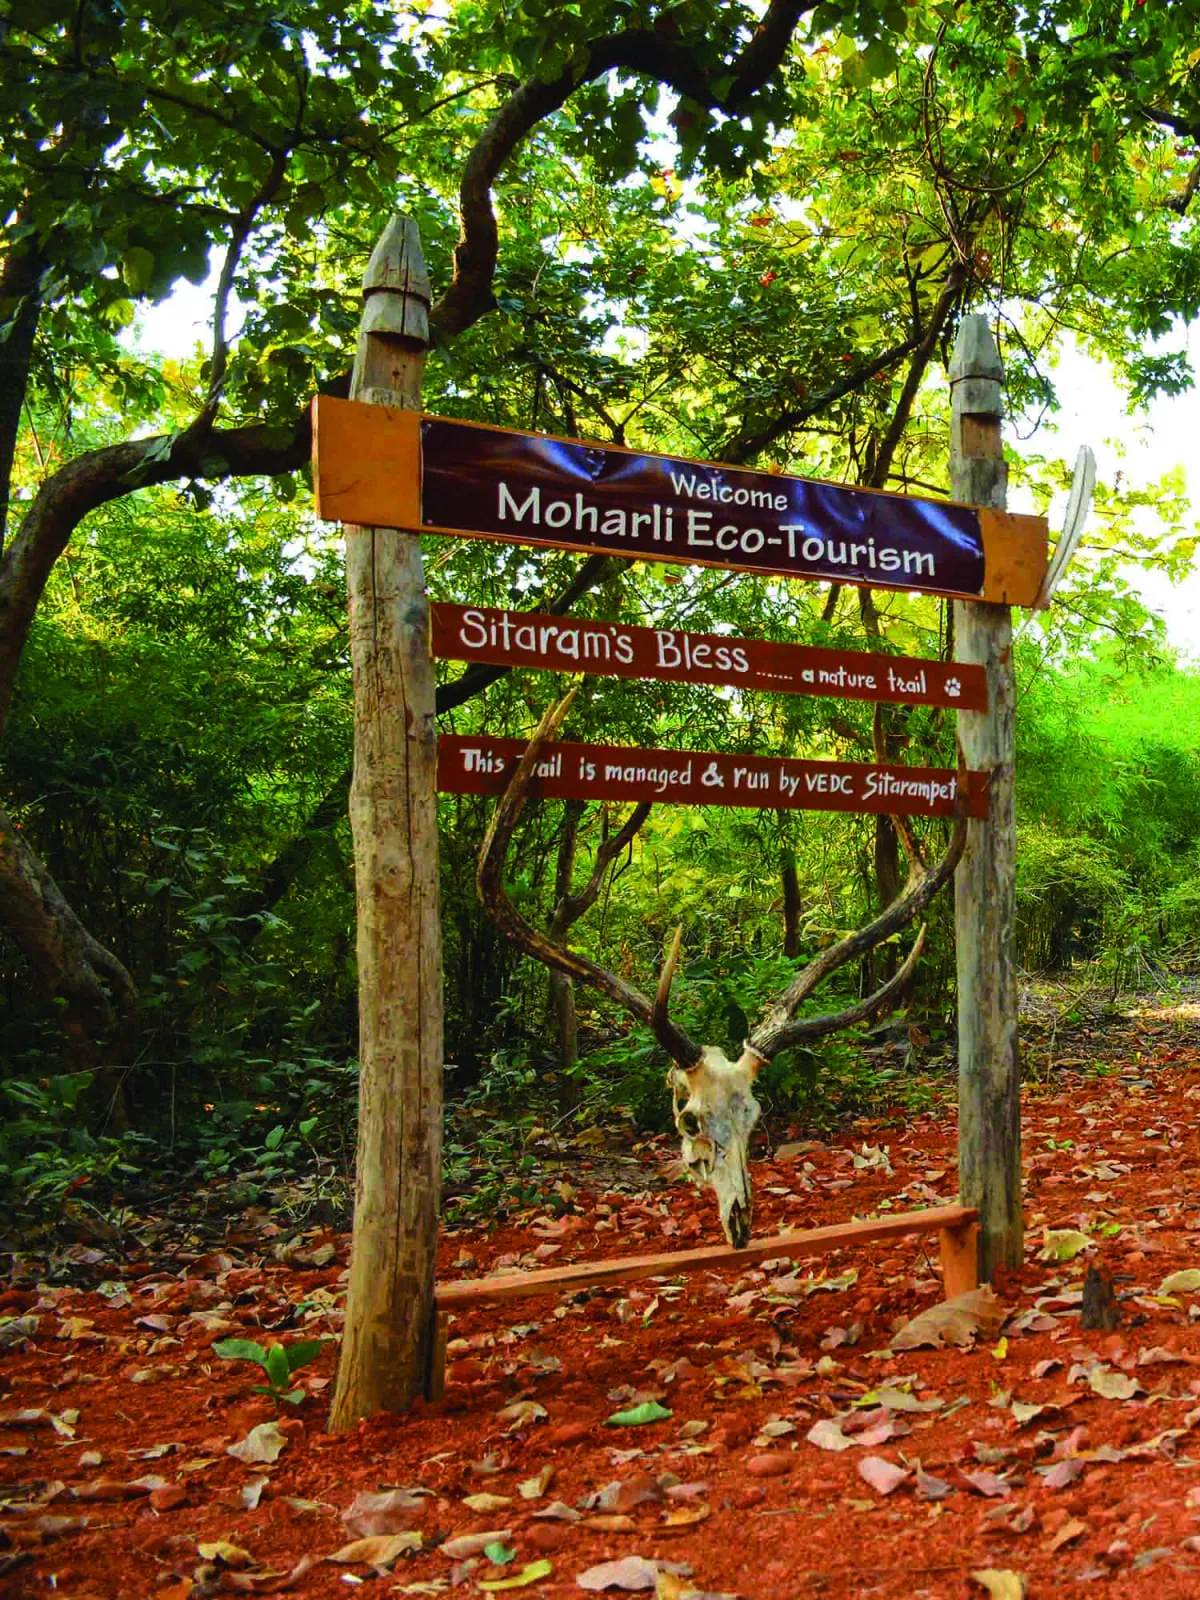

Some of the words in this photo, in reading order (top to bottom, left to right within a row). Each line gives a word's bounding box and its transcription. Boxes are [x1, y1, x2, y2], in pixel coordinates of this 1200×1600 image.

[670, 471, 788, 511] Welcome
[498, 481, 673, 543] Moharli
[687, 510, 935, 577] Eco-Tourism
[460, 611, 633, 664] Sitaram's
[655, 630, 749, 673] Bless
[802, 668, 814, 683] a
[819, 665, 877, 690] nature
[888, 667, 926, 694] trail
[460, 749, 504, 773] This
[579, 757, 596, 780] is
[605, 759, 692, 793] managed
[701, 761, 724, 787] &
[734, 766, 769, 790] run
[779, 765, 799, 797] by
[804, 772, 854, 795] VEDC
[861, 771, 958, 806] Sitarampet
